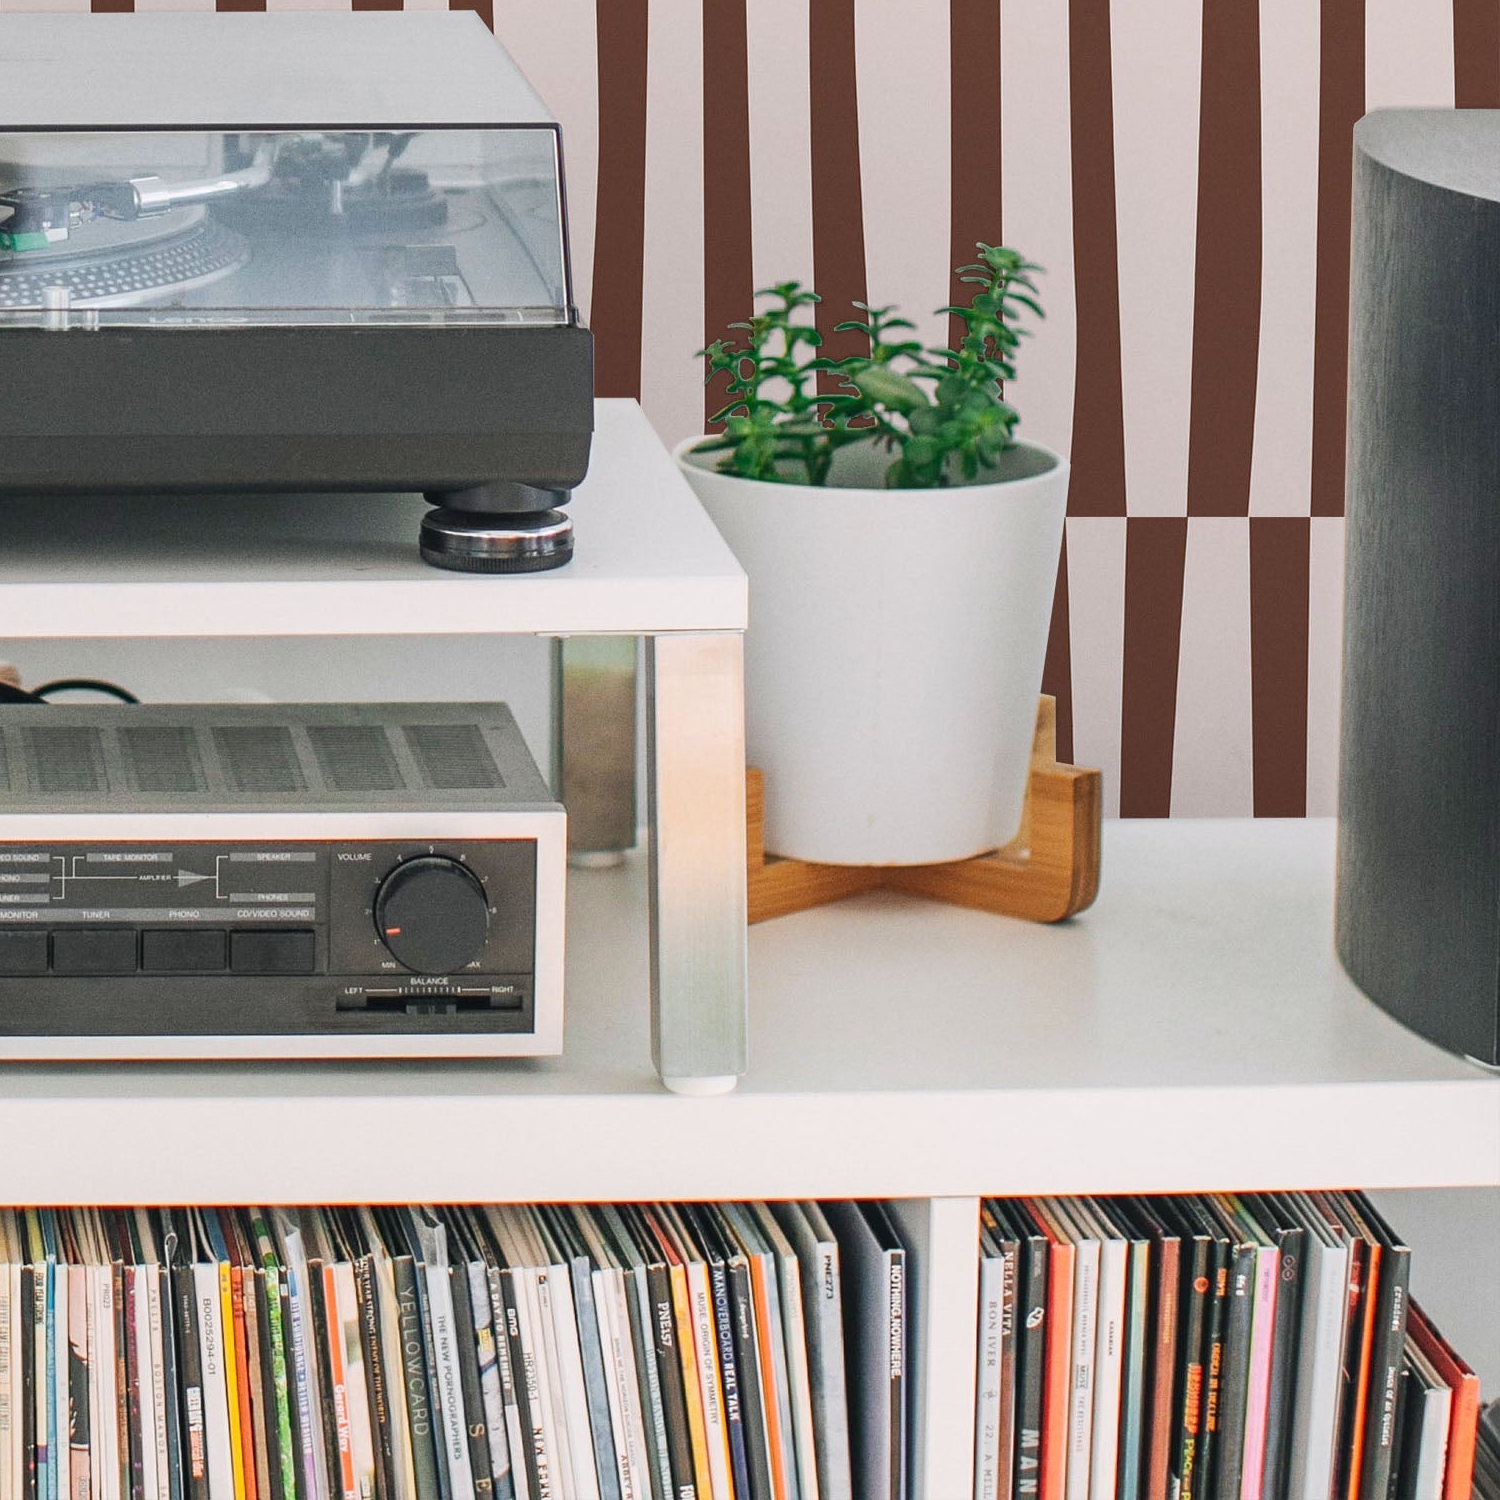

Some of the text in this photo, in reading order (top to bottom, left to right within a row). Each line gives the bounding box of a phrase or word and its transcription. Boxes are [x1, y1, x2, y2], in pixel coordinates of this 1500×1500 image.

[13, 853, 39, 862] SOUND
[103, 853, 158, 861] TAPE MONITOR
[257, 853, 291, 861] SPEAKER
[338, 853, 372, 862] VOLUME
[0, 911, 38, 920] MONITOR
[82, 911, 110, 920] TUNER
[169, 911, 199, 919] PHONO
[237, 910, 310, 919] CD/VIDEO SOUND
[382, 961, 396, 969] MIN
[345, 986, 363, 994] LEFT
[410, 977, 449, 986] BALANCE
[492, 985, 515, 993] RIGHT
[822, 1254, 835, 1300] PNE273
[34, 1272, 46, 1325] FOUR YEAR STRONG
[492, 1293, 502, 1315] DAY
[1000, 1251, 1017, 1337] NELLA VITA
[1390, 1286, 1403, 1331] grandson
[495, 1318, 504, 1332] TO
[507, 1308, 519, 1337] BMG
[658, 1301, 674, 1347] PNE157
[986, 1301, 998, 1332] BON
[201, 1298, 218, 1376] B0025294-01
[700, 1323, 712, 1356] ORIGIN
[984, 1336, 997, 1368] IVER
[1106, 1320, 1116, 1357] KASABIAN
[399, 1286, 429, 1437] YELLOWCARD
[497, 1335, 512, 1390] REMEMBER
[524, 1352, 538, 1401] HR2350-1
[704, 1358, 714, 1372] OF
[724, 1362, 736, 1390] REAL
[1386, 1366, 1396, 1388] Death
[152, 1363, 164, 1408] BOSTON
[438, 1315, 461, 1461] THE NEW PORNOGRAPHERS
[706, 1373, 719, 1425] SYMMETRY
[334, 1384, 350, 1453] Gerard Way
[727, 1393, 739, 1421] TALK
[156, 1414, 167, 1455] MANOR
[469, 1424, 491, 1493] S E
[620, 1454, 631, 1490] ABBEY
[1020, 1428, 1040, 1493] MAN
